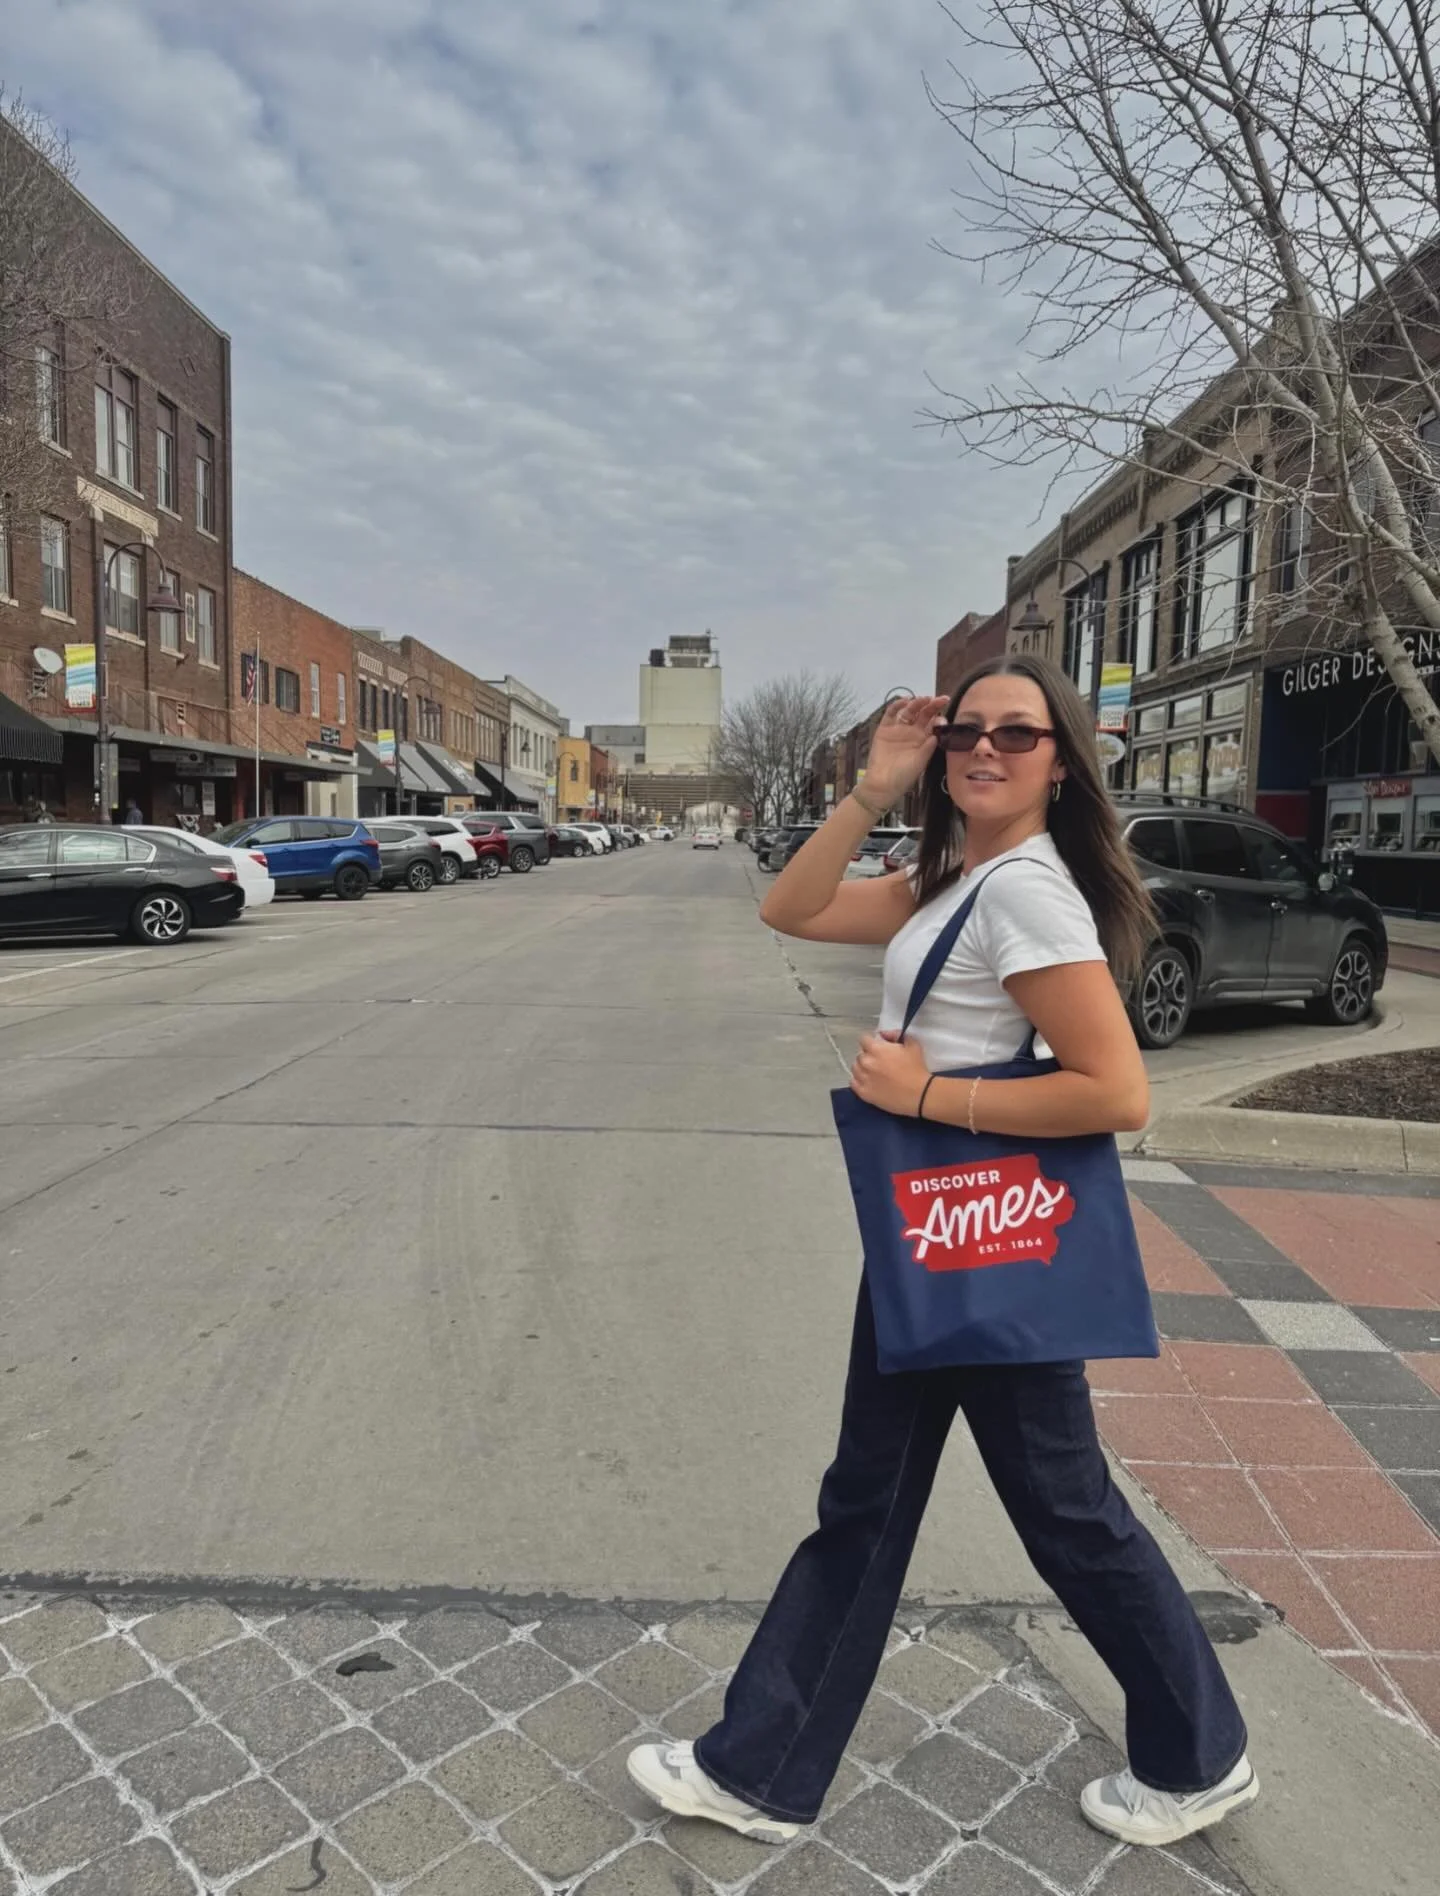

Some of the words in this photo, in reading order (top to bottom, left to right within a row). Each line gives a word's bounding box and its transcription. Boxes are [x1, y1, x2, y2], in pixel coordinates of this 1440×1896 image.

[1282, 657, 1341, 696] GILGER
[1352, 631, 1440, 681] DEGN
[910, 1170, 1001, 1195] DISCOVER
[905, 1177, 1065, 1260] Ames
[979, 1243, 1006, 1255] EST.
[1011, 1238, 1043, 1250] 1864
